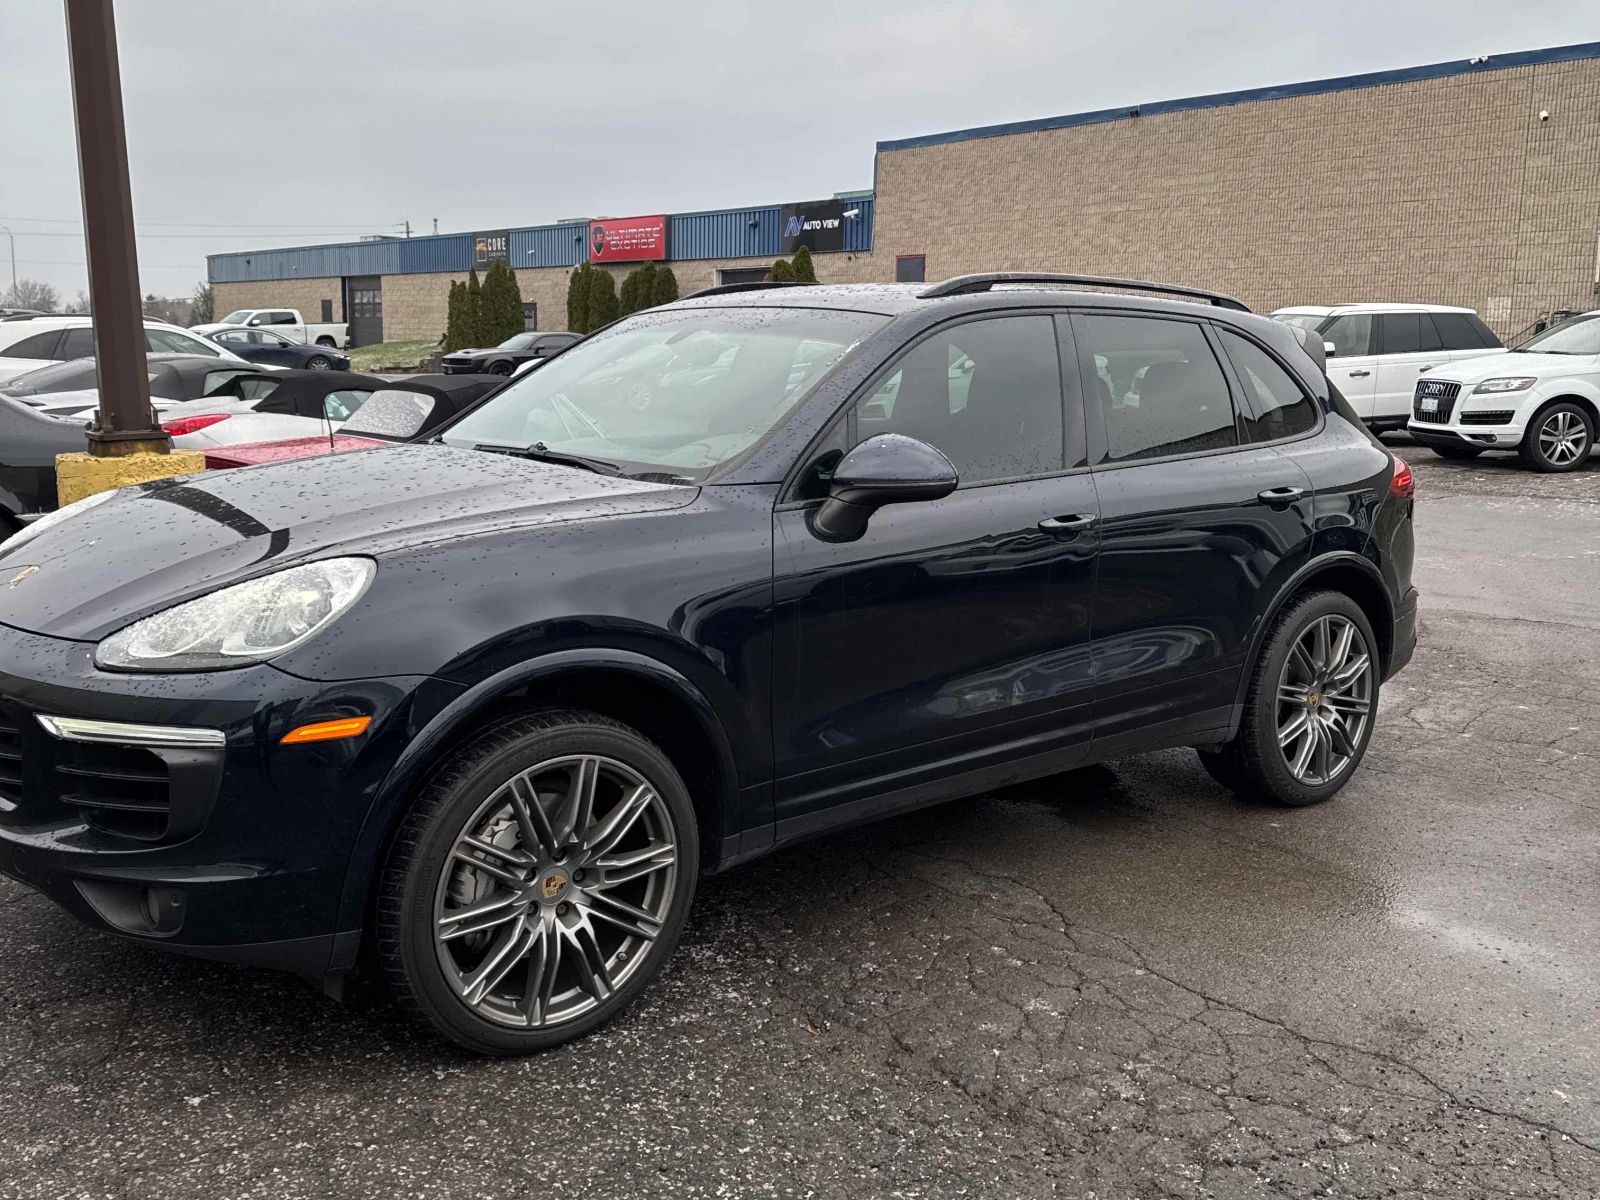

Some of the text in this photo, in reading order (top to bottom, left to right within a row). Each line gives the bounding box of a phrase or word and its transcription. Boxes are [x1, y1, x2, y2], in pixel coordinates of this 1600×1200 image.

[803, 220, 821, 230] AUTO
[822, 219, 840, 228] VIEW
[605, 227, 660, 240] ULTIMATE
[488, 237, 506, 251] CORE
[610, 238, 656, 250] EXOTICS
